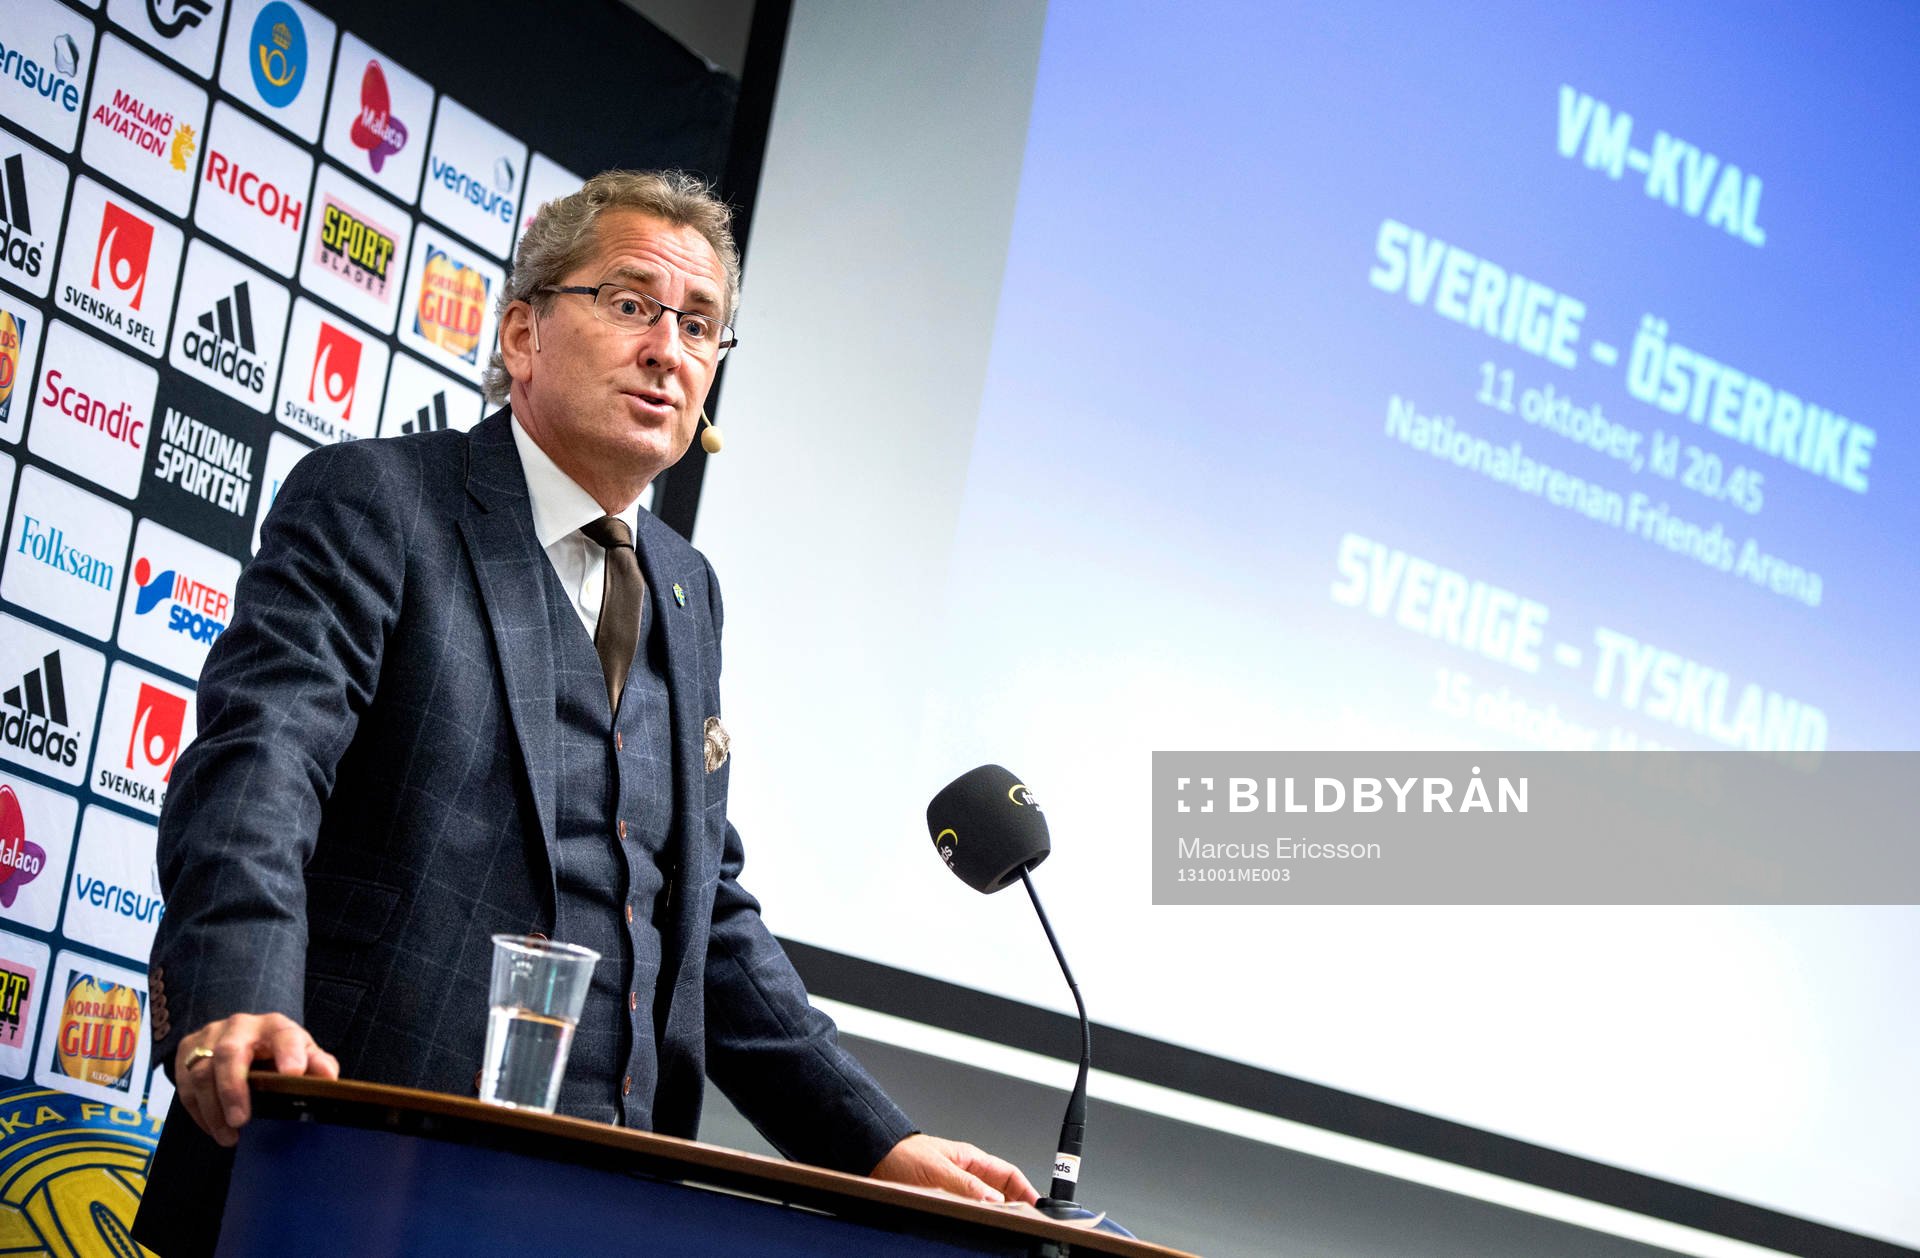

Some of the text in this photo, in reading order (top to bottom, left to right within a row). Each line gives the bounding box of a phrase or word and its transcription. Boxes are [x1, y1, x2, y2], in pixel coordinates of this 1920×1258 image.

[92, 104, 167, 158] AVIATION
[112, 88, 174, 136] MALMÖ
[206, 150, 303, 232] RICOH
[432, 156, 514, 223] verisure
[1556, 82, 1766, 248] VM-KVAL
[320, 250, 385, 295] BLADET
[322, 203, 395, 282] SPORT
[64, 285, 157, 348] SVENSKA SPEL
[420, 288, 482, 337] GULD
[183, 329, 266, 394] adidas
[1369, 217, 1586, 370] SVERIGE
[1626, 312, 1878, 494] ÖSTERRIKE
[42, 369, 144, 449] Scandic
[284, 401, 335, 438] SVENSKA
[1477, 361, 1765, 515] 11 oktober, kl 20.45
[161, 407, 253, 481] NATIONAL
[155, 442, 251, 517] SPORTEN
[1386, 396, 1824, 606] Nationalarenan Friends Arena
[17, 514, 114, 592] Folksam
[174, 574, 229, 621] INTER
[1331, 532, 1549, 674] SVERIGE
[1593, 626, 1829, 773] TYSKLAND
[99, 770, 155, 805] SVENSKA
[61, 1020, 136, 1061] GULD
[66, 1000, 138, 1022] NORRLANDS
